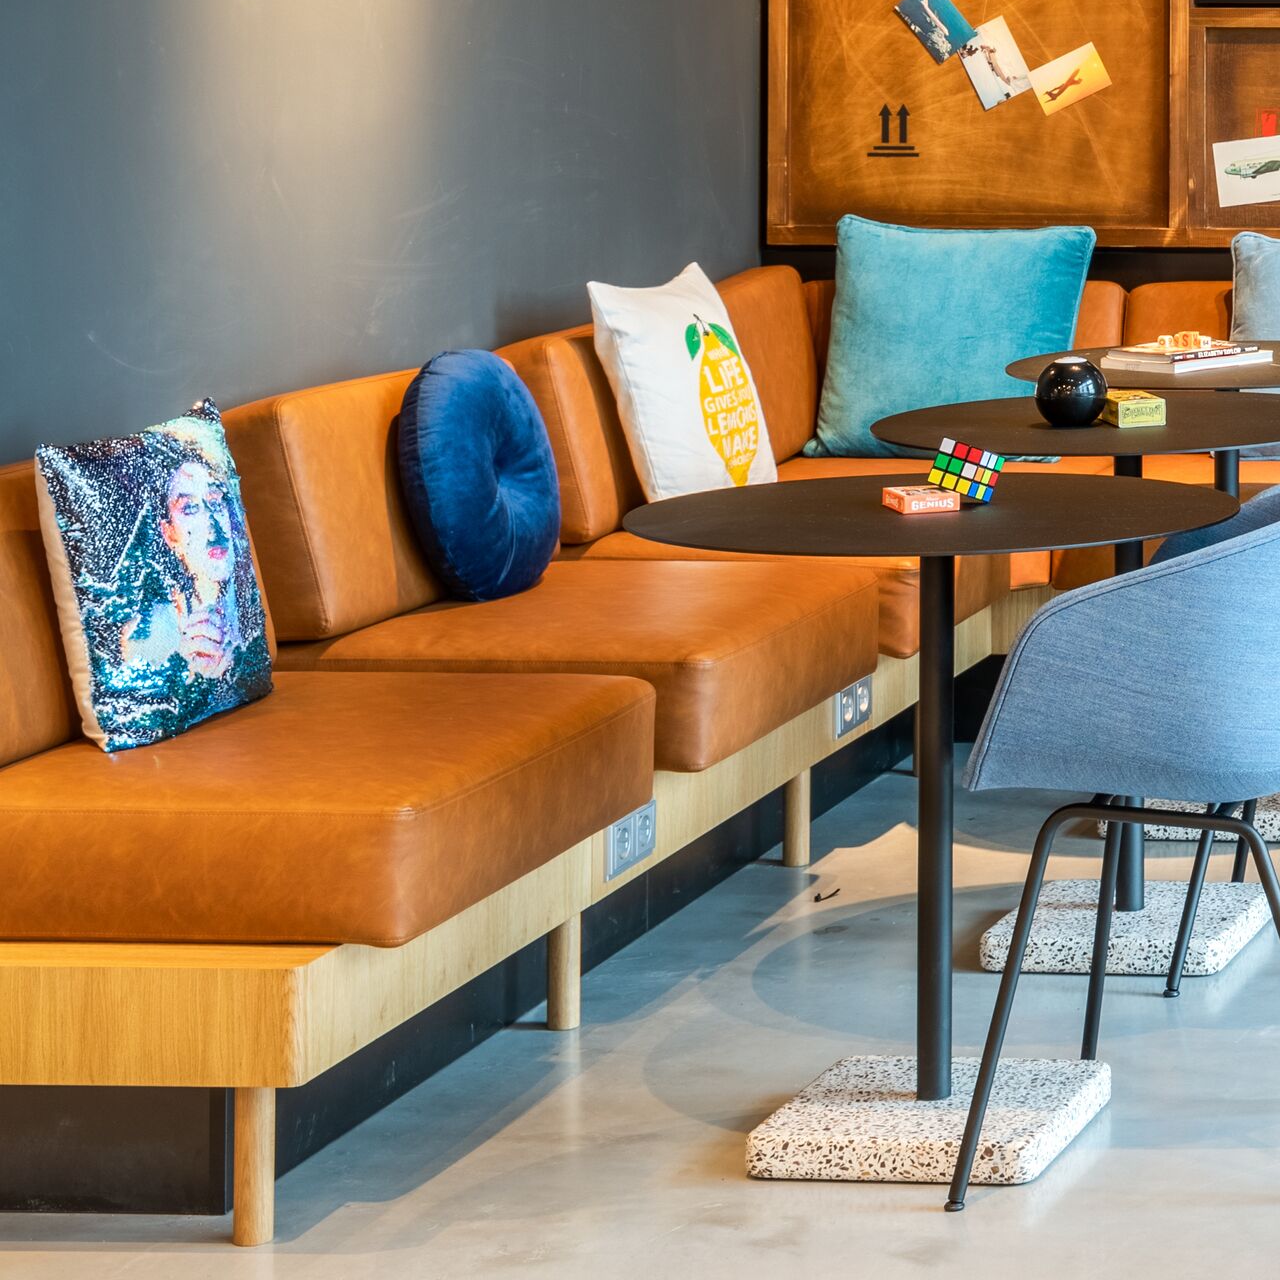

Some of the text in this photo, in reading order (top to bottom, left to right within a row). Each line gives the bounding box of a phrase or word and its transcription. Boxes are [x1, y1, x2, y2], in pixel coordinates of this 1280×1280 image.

[703, 356, 745, 394] LIFE
[704, 388, 738, 414] GIVES
[707, 401, 758, 436] LEMONS
[722, 425, 758, 459] MAKE
[911, 497, 955, 511] GENIUS
